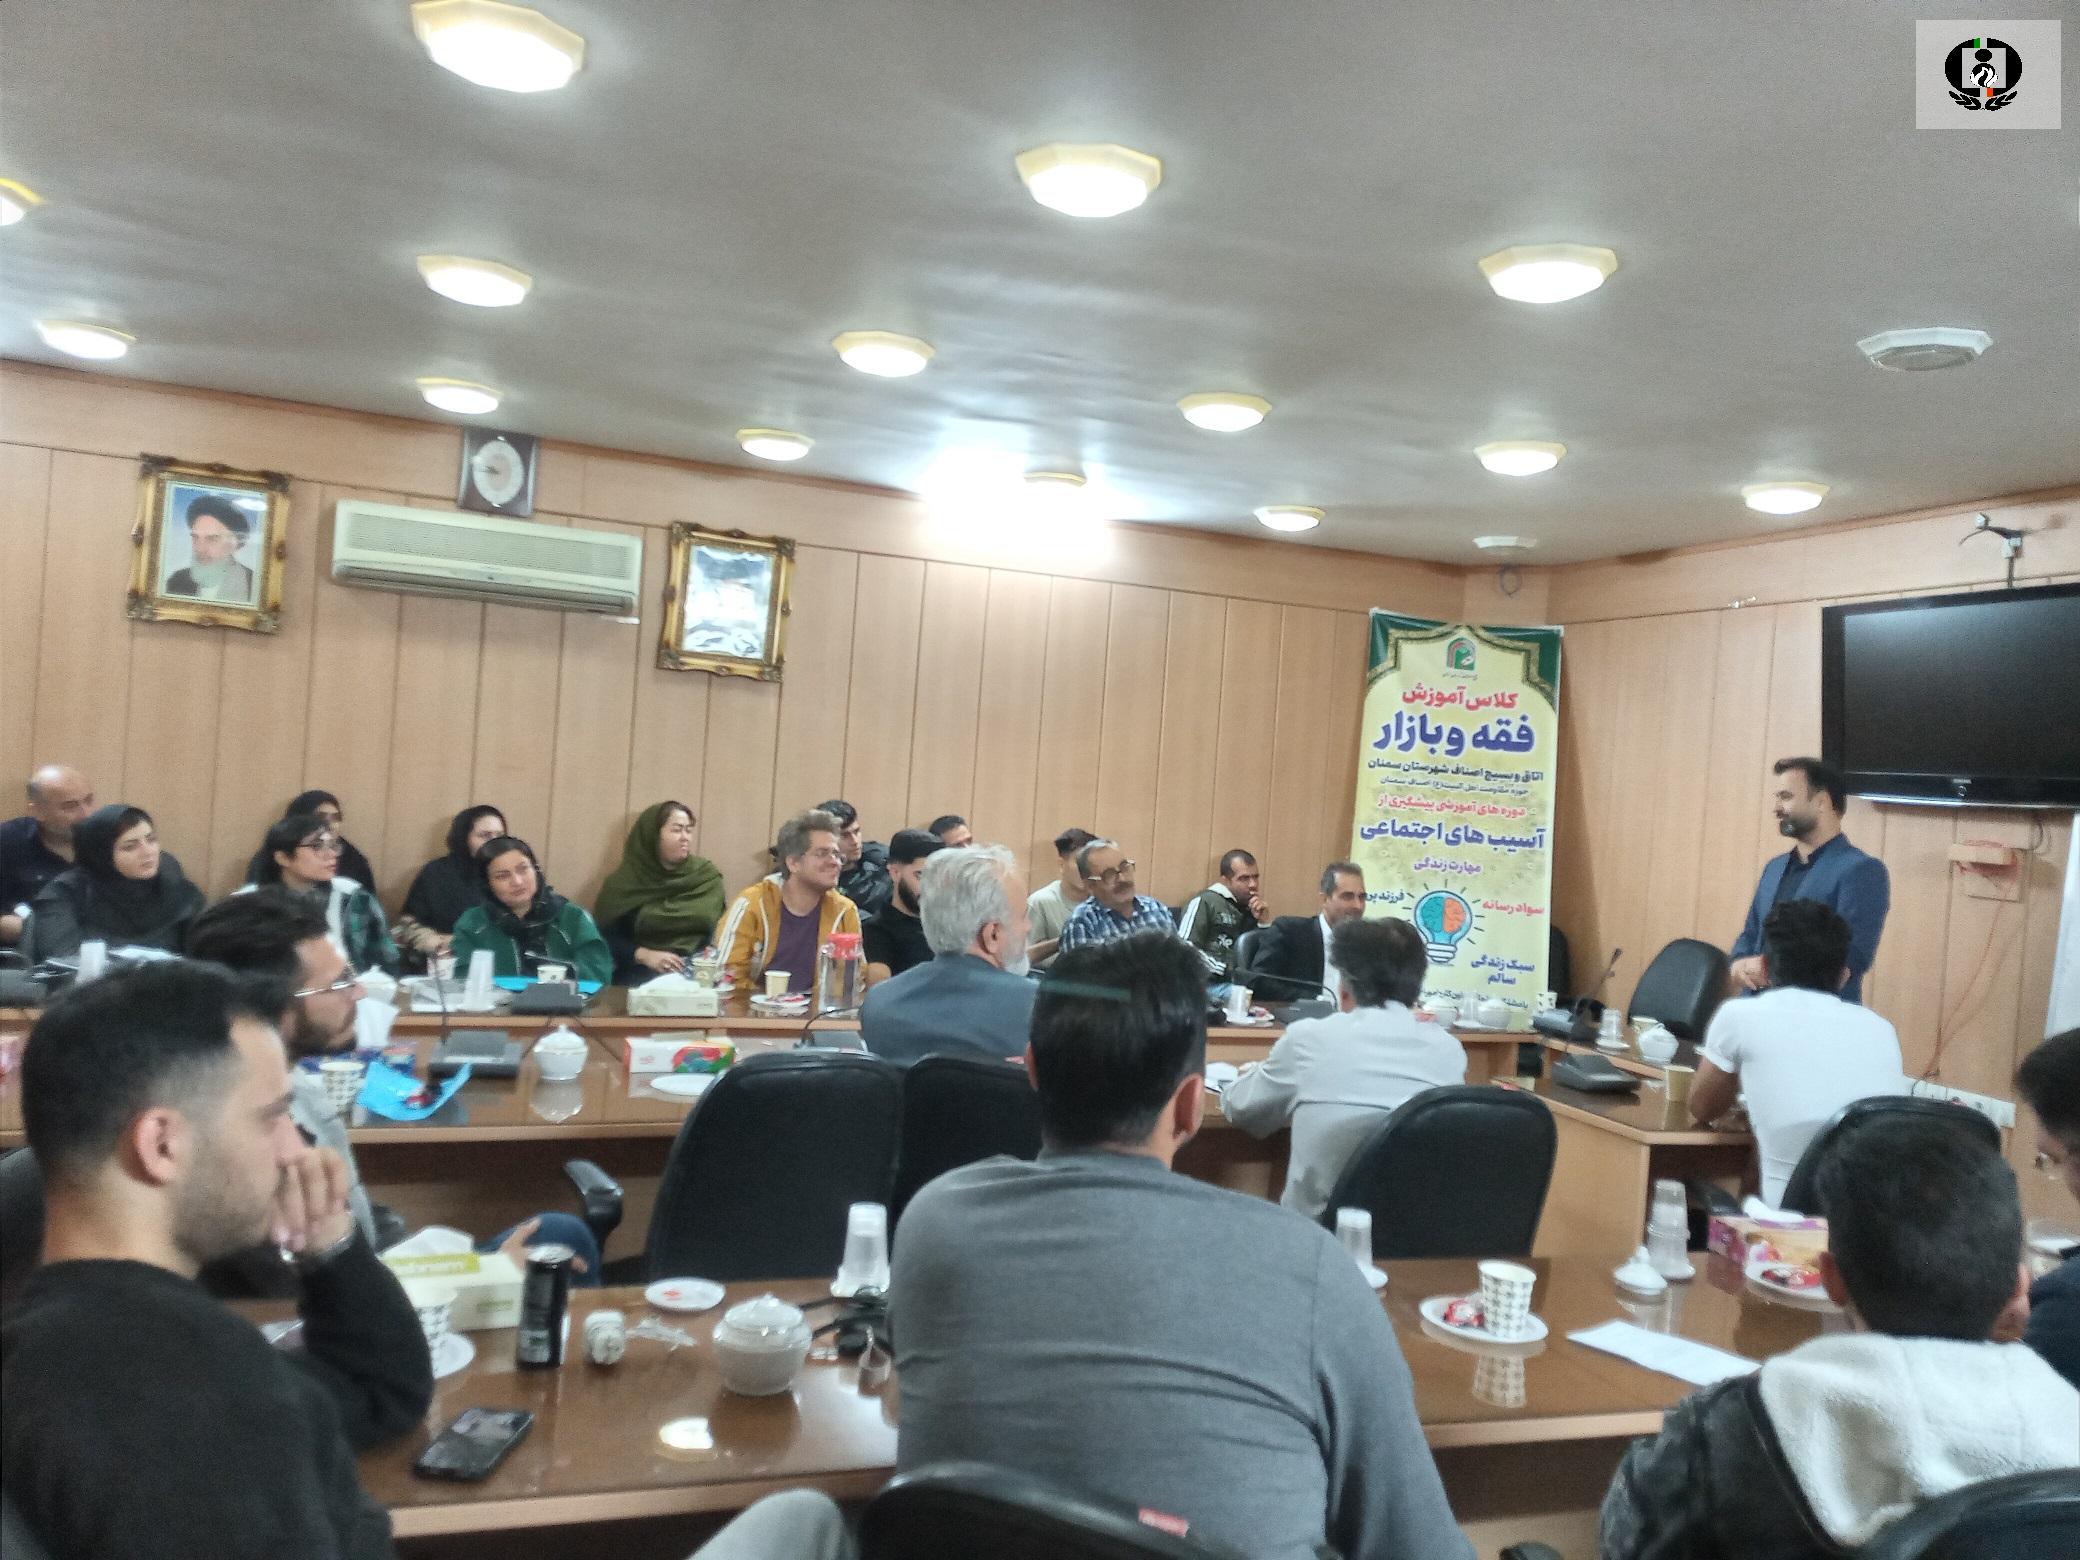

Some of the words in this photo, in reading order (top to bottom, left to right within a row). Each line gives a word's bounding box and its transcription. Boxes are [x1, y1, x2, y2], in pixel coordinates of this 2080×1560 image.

[1402, 682, 1466, 708] آموزش
[1465, 691, 1519, 710] کلاس
[1471, 714, 1536, 753] فقه
[1367, 757, 1402, 769] سمنان
[1402, 761, 1450, 775] شهرستان
[1450, 763, 1484, 777] اصناف
[1521, 769, 1544, 783] اتاق
[1378, 794, 1389, 807] از
[1388, 795, 1436, 812] پیشگیری
[1436, 799, 1477, 814] آموزشی
[1501, 806, 1526, 819] دوره
[1360, 818, 1443, 845] اجتماعی
[1444, 824, 1486, 846] های
[1487, 828, 1547, 853] آسیب
[1413, 856, 1450, 873] زندگی
[1449, 860, 1482, 874] مهارت
[1481, 899, 1515, 915] رسانه
[1514, 902, 1545, 916] سواد
[1470, 954, 1505, 971] زندگی
[1502, 958, 1536, 975] سبک
[1487, 972, 1517, 985] سالم
